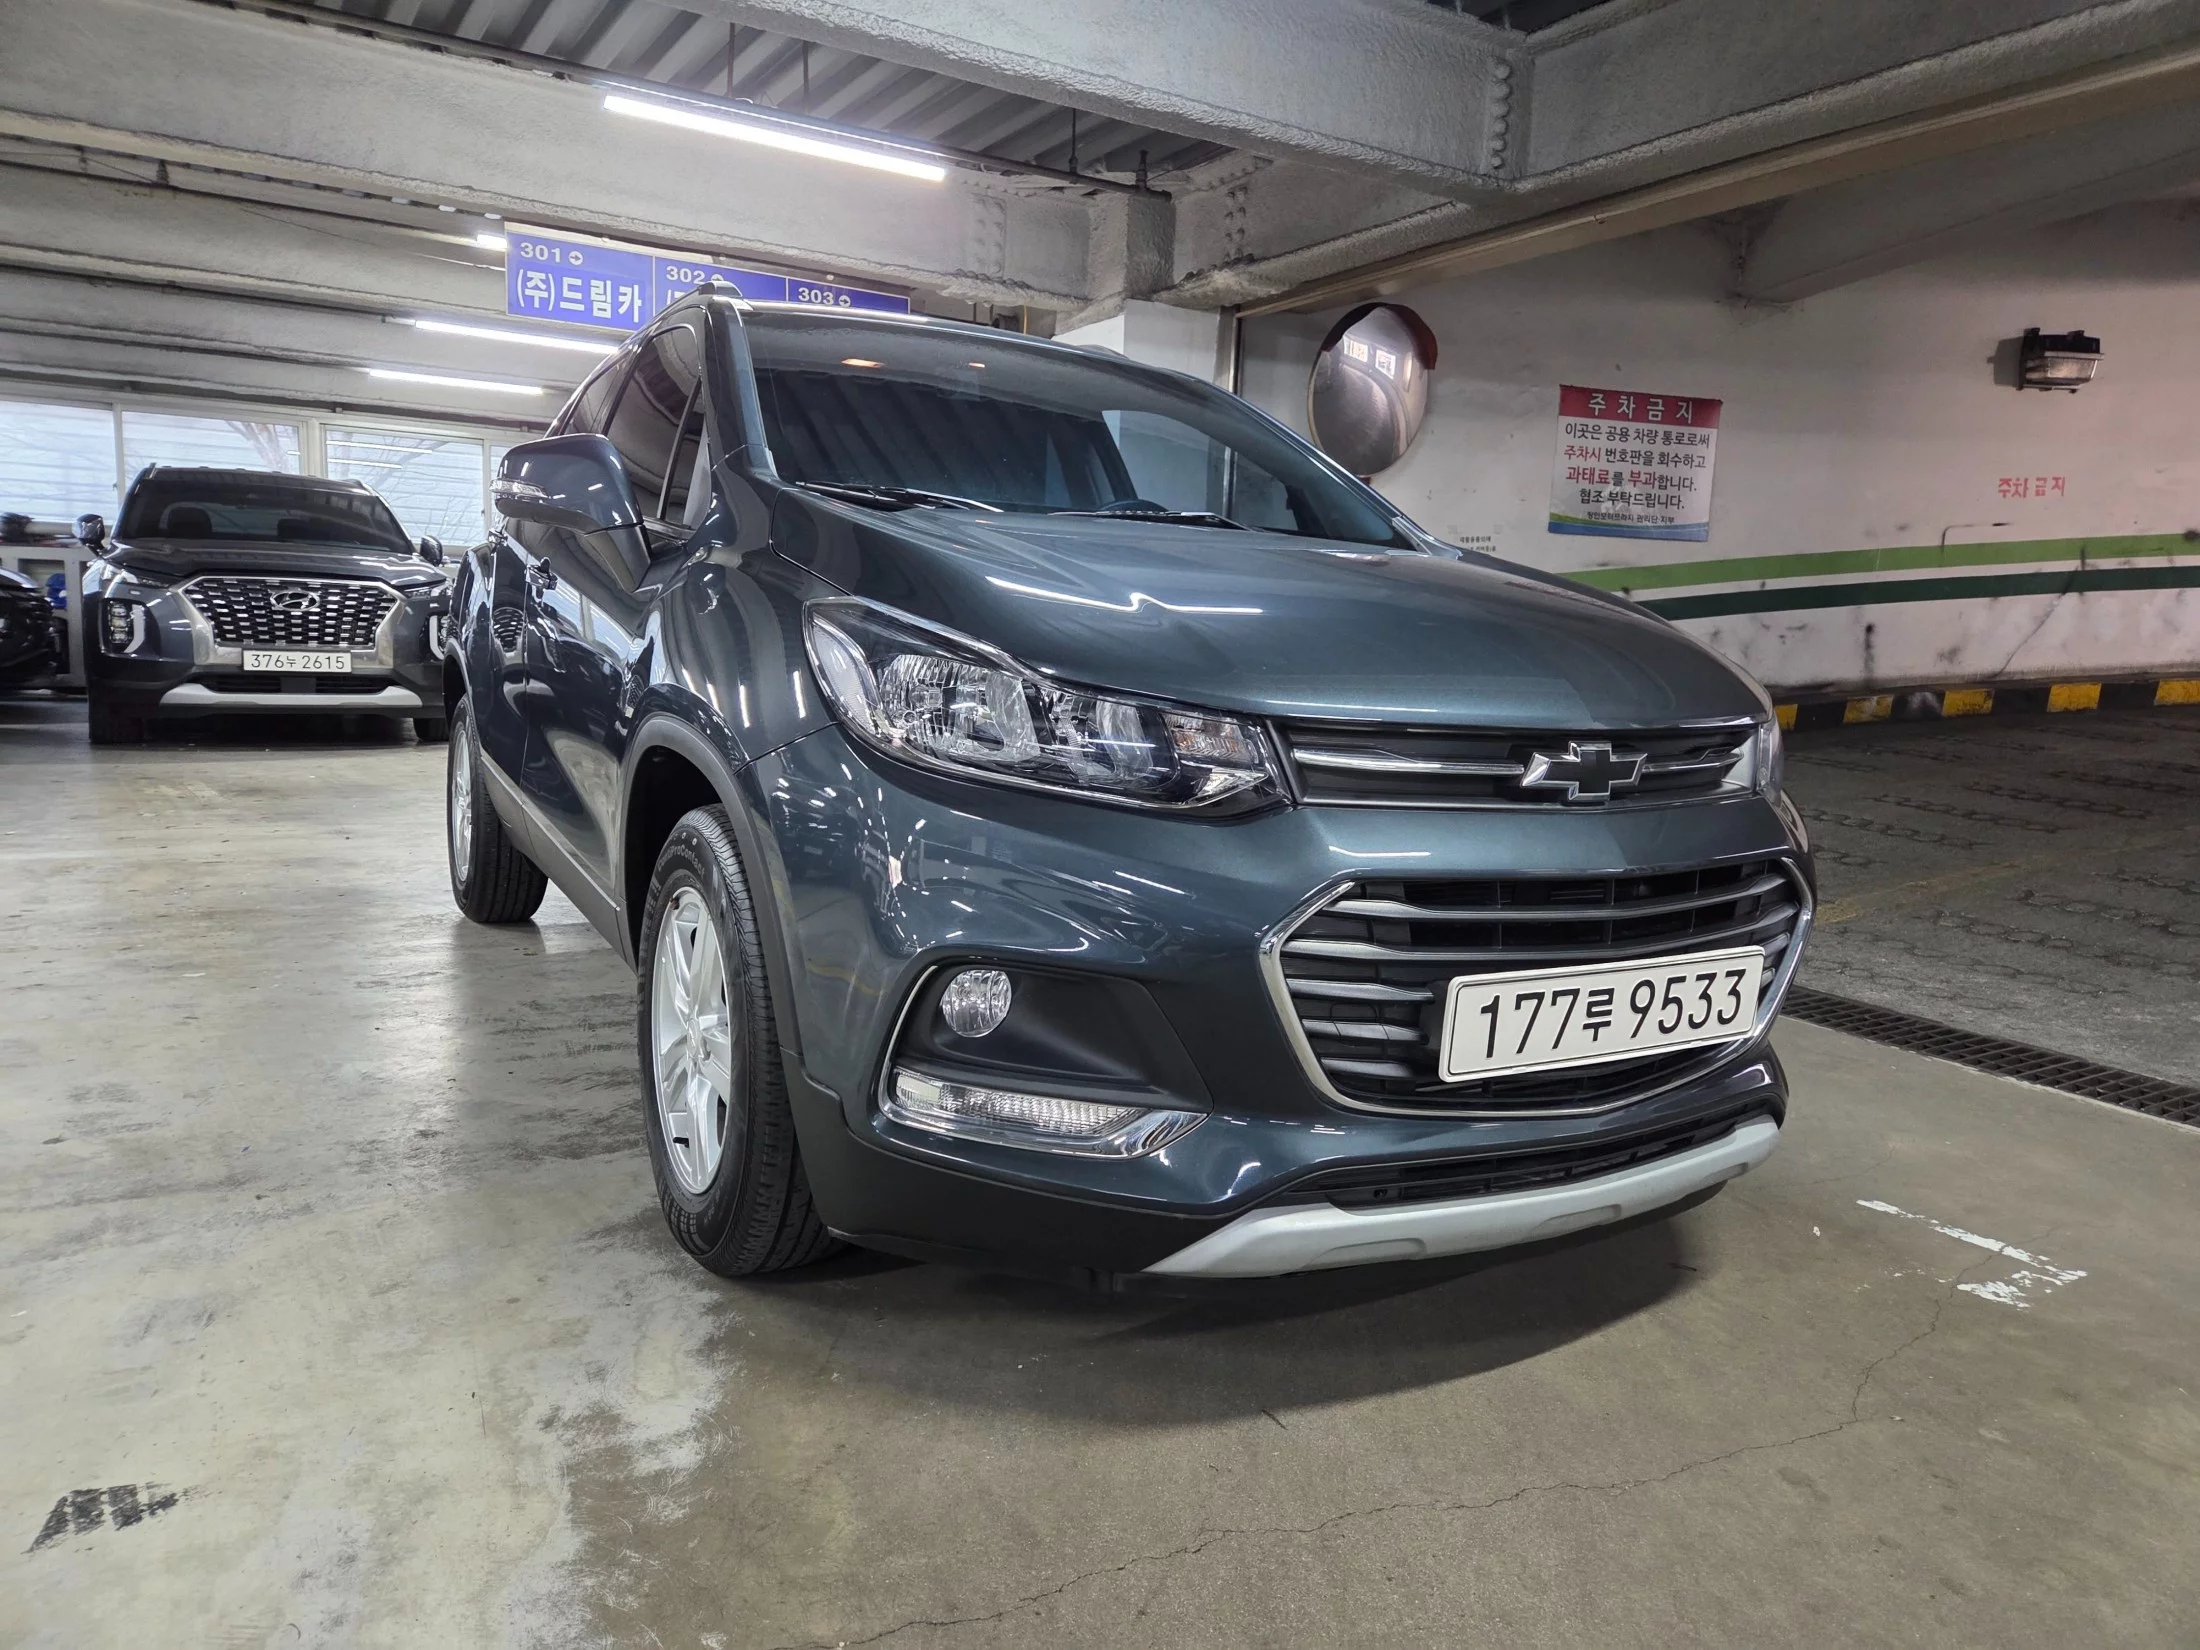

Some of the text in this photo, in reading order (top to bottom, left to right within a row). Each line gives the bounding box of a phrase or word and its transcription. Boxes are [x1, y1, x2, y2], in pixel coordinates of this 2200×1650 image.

[520, 242, 561, 263] 301
[666, 265, 706, 285] 302
[517, 268, 642, 323] (주)드림카
[798, 287, 835, 305] 303
[1565, 422, 1710, 448] 이곳은 공용 차량 통로로써
[1564, 445, 1706, 469] 주차시 번호판을 회수하고
[1566, 466, 1697, 492] 과태료를 부과합니다.
[1579, 488, 1604, 504] 협조
